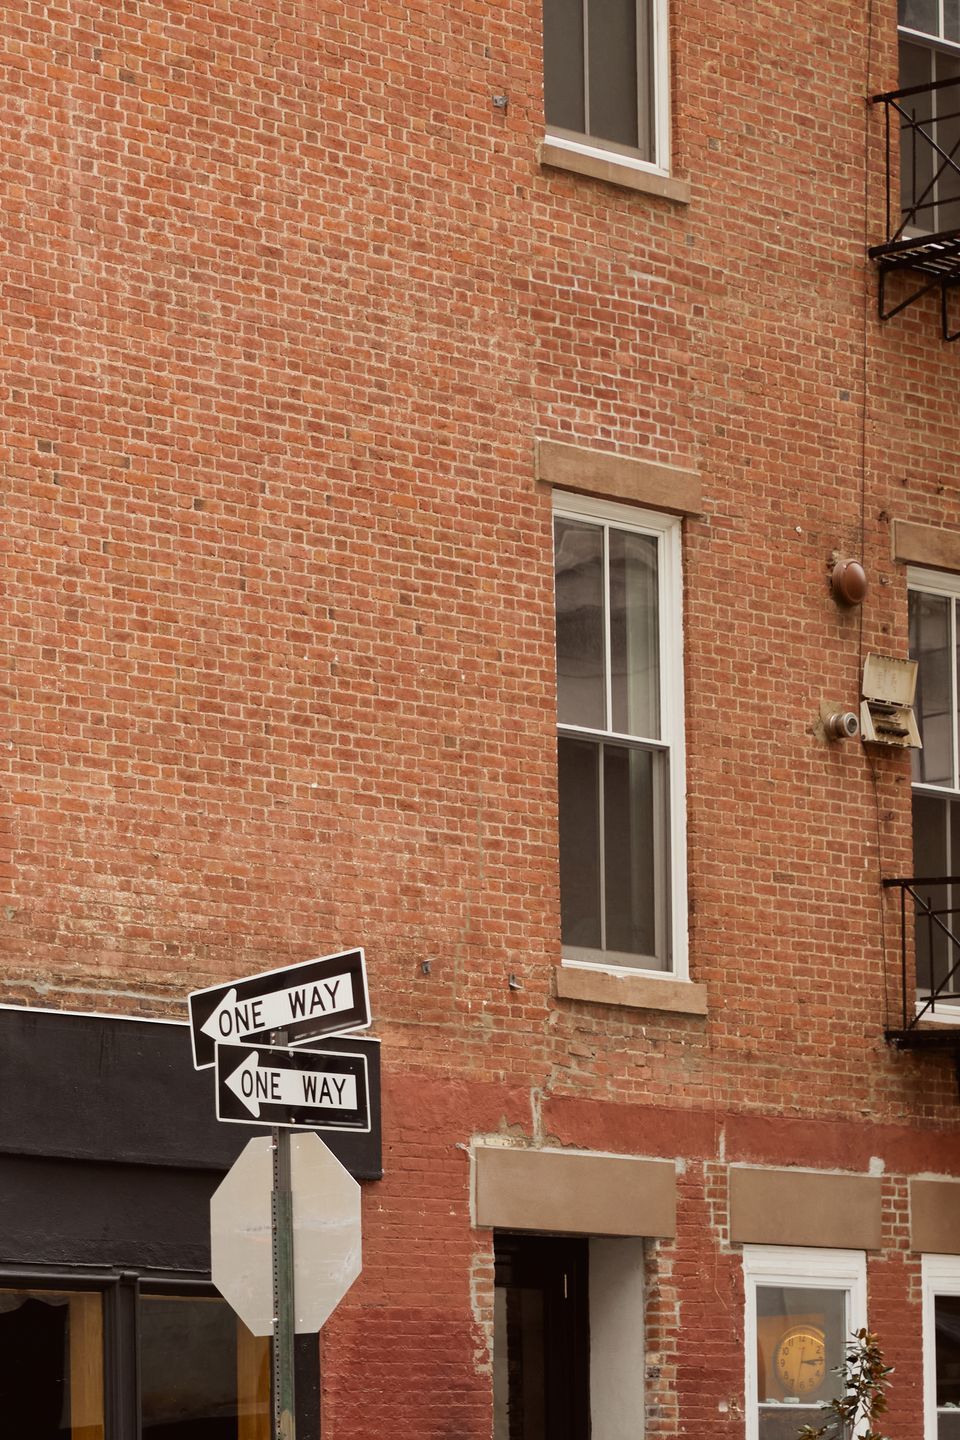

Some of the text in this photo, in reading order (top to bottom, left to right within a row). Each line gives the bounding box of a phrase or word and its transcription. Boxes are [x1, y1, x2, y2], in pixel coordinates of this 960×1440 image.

[219, 980, 340, 1037] ONE WAY
[241, 1069, 346, 1105] ONE WAY
[782, 1346, 790, 1356] 10
[816, 1346, 820, 1354] 2
[780, 1358, 785, 1368] 9
